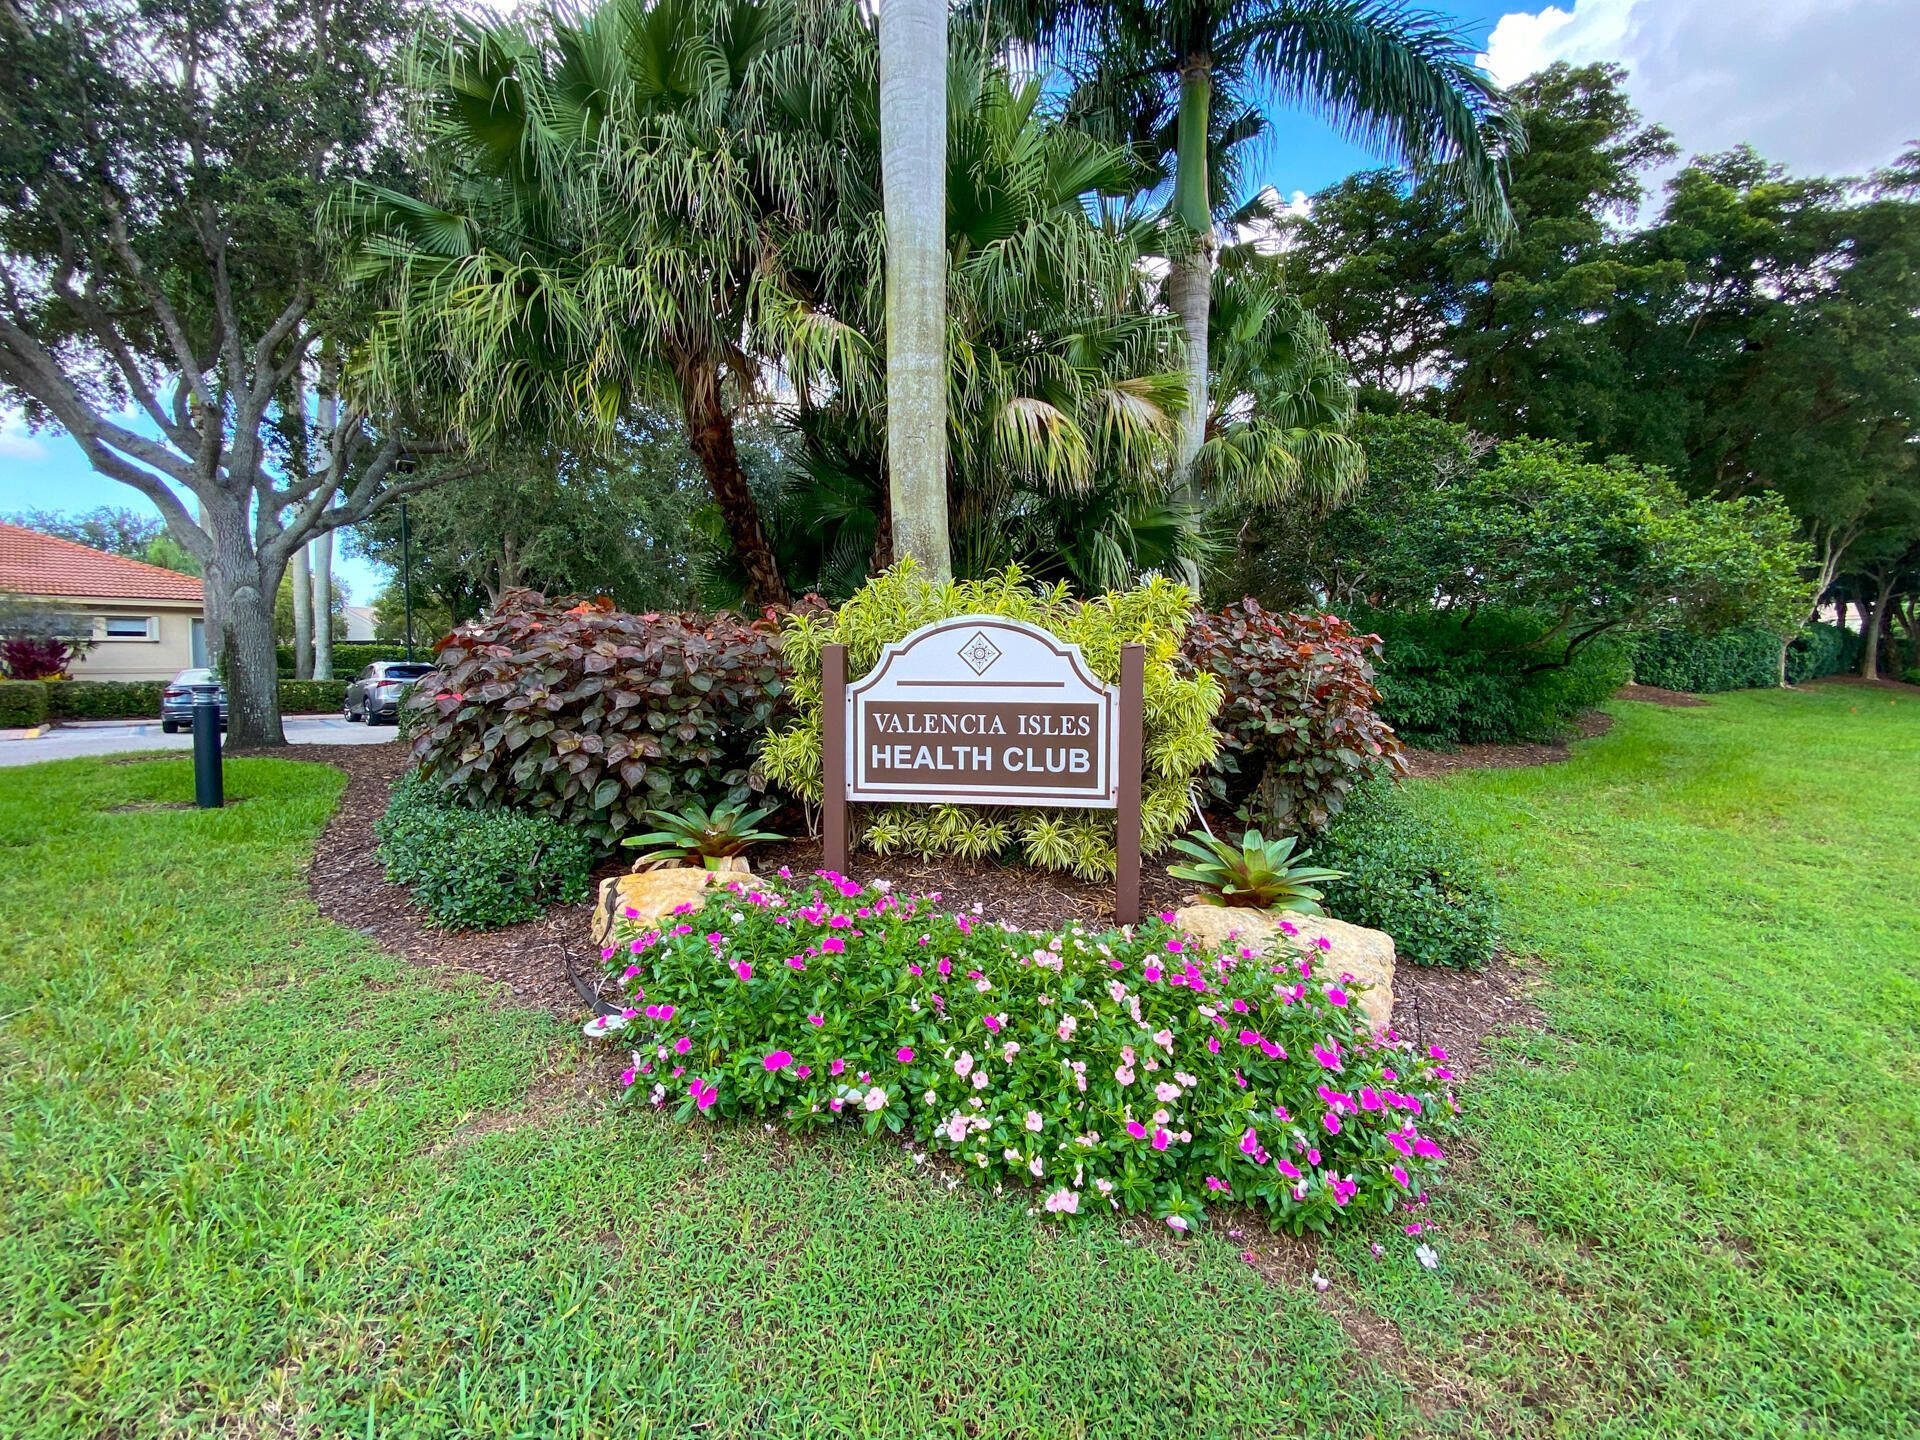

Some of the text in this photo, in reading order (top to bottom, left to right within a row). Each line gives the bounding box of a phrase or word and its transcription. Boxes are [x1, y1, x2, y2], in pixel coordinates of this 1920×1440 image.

[872, 713, 1090, 736] VALENCIA ISLES
[872, 745, 1091, 773] HEALTH CLUB
